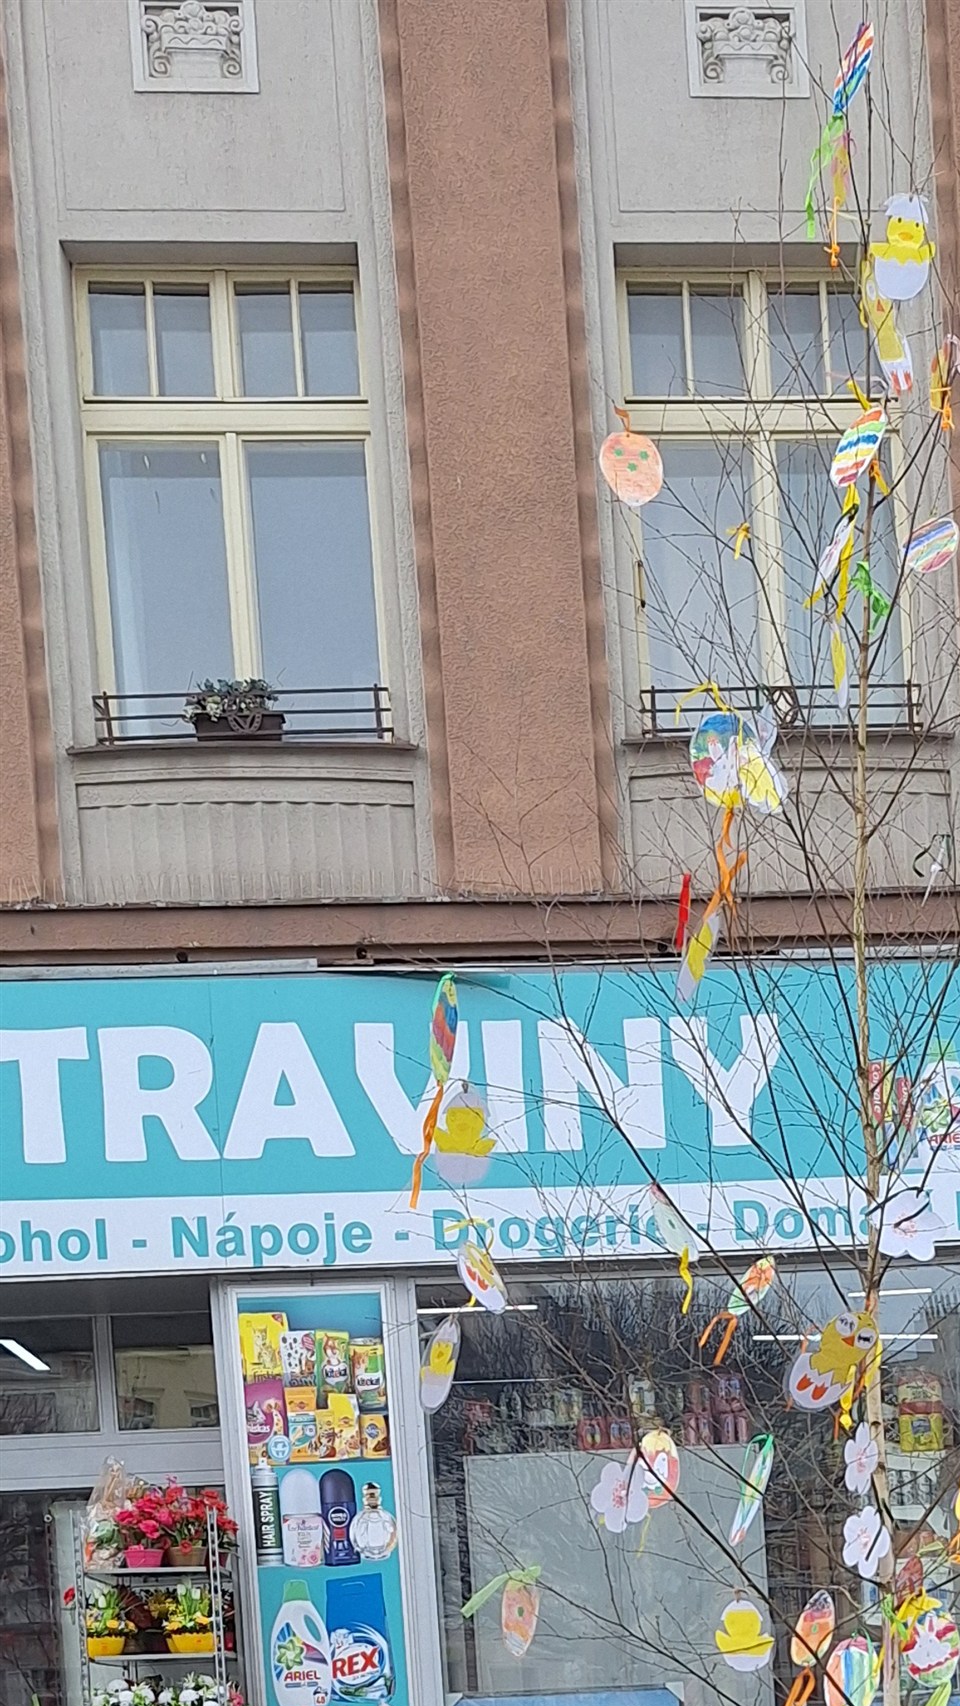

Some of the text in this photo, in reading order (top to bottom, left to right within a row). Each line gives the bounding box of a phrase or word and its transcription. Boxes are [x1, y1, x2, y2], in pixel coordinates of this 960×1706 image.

[0, 1013, 778, 1164] TRAVINY
[132, 1239, 147, 1248] -
[171, 1212, 373, 1267] Nápoje
[395, 1230, 409, 1241] -
[258, 1491, 276, 1547] HAIR SPRAY
[284, 1670, 320, 1682] ARIEL
[332, 1647, 379, 1679] REX
